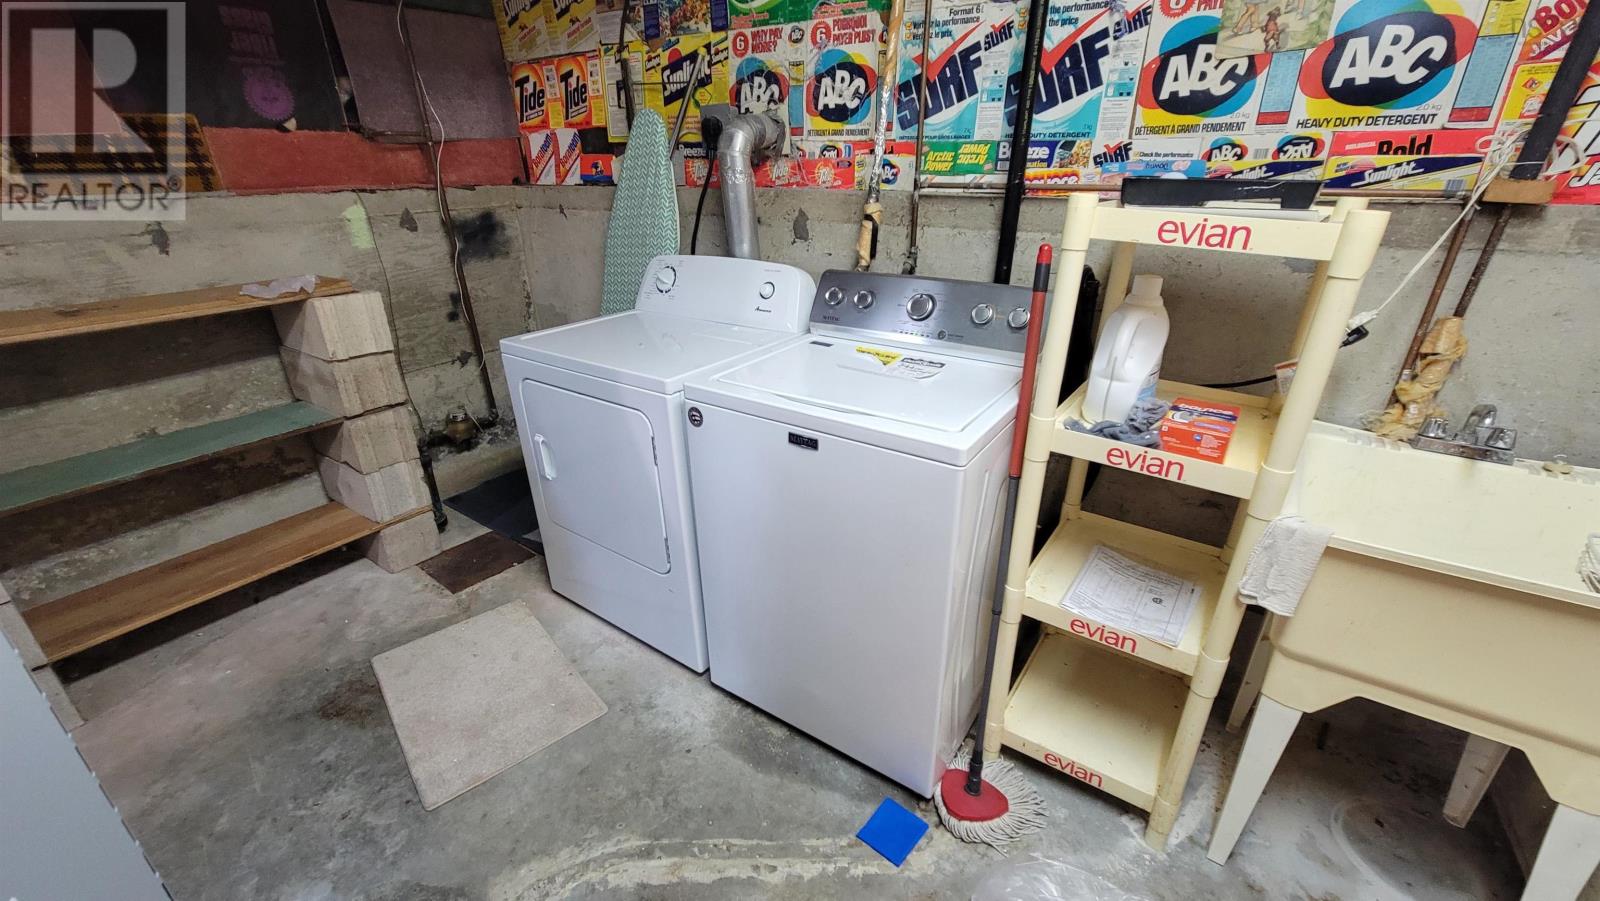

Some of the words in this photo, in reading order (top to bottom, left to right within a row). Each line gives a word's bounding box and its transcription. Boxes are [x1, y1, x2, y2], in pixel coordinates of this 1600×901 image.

[949, 6, 974, 16] Format
[1050, 5, 1061, 14] the
[1062, 0, 1110, 13] performance
[833, 15, 867, 32] POURQUOI
[941, 15, 981, 27] performance
[1048, 18, 1060, 27] the
[1060, 16, 1078, 27] price
[751, 29, 769, 43] WHY
[769, 27, 783, 40] PAY
[816, 28, 827, 44] 6
[833, 32, 854, 45] PAYER
[941, 29, 953, 39] prix
[984, 20, 1014, 52] SURF
[737, 39, 745, 50] 6
[752, 41, 777, 54] MORE?
[1329, 24, 1448, 89] ABC
[1159, 44, 1249, 100] ABC
[560, 69, 588, 120] Tide
[817, 69, 866, 112] ABC
[515, 75, 545, 123] Tide
[1176, 121, 1200, 134] GRAND
[1296, 118, 1333, 129] HEAVY
[1333, 116, 1364, 128] DUTY
[1365, 113, 1438, 126] DETERGENT
[1377, 133, 1434, 156] Bold
[926, 151, 955, 161] Arctic
[1210, 145, 1241, 161] ABC
[924, 160, 953, 171] Power
[1351, 160, 1425, 187] Sunlight
[1157, 218, 1252, 250] evian
[1106, 447, 1184, 481] evian
[1070, 618, 1137, 653] evian
[1043, 752, 1103, 788] evian
